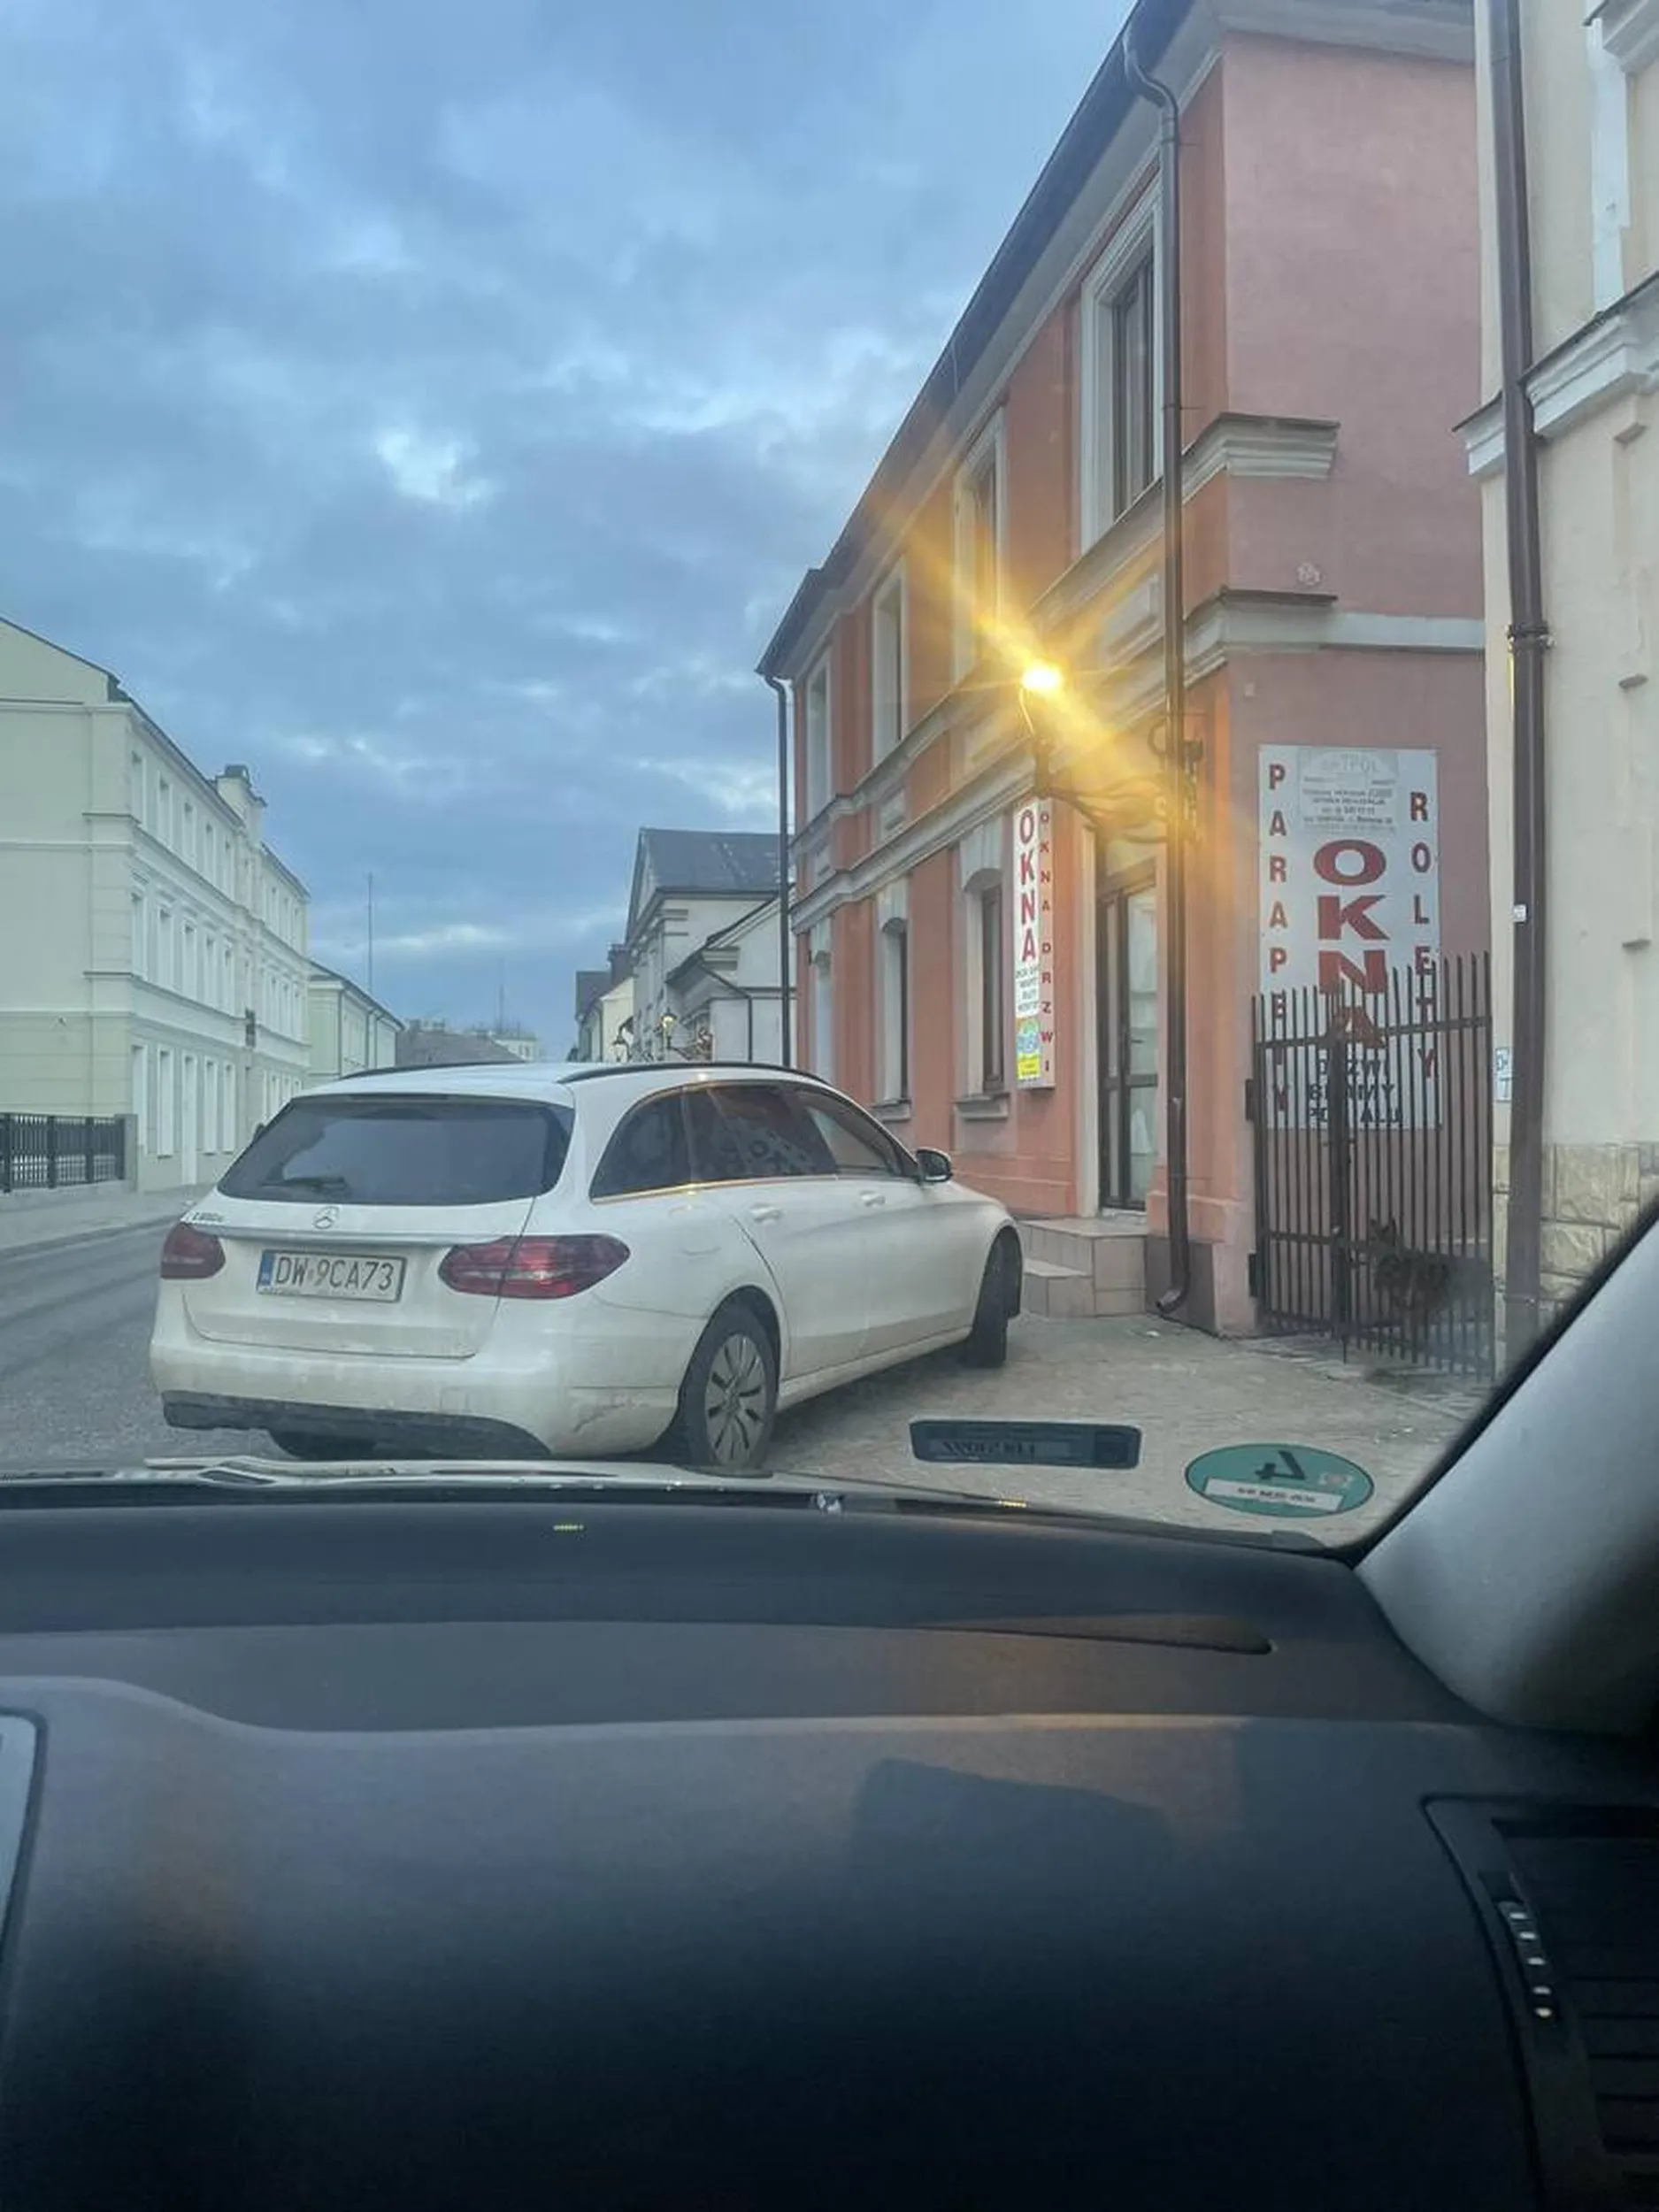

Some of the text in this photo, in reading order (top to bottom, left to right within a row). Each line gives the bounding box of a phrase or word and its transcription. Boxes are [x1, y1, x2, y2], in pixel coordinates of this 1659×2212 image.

[1019, 810, 1036, 962] OKNA
[1040, 813, 1054, 1072] OKNA DRZWI
[1314, 840, 1390, 1050] OKNA
[1410, 792, 1435, 1079] ROLETY
[275, 1256, 395, 1292] DW 9CA73
